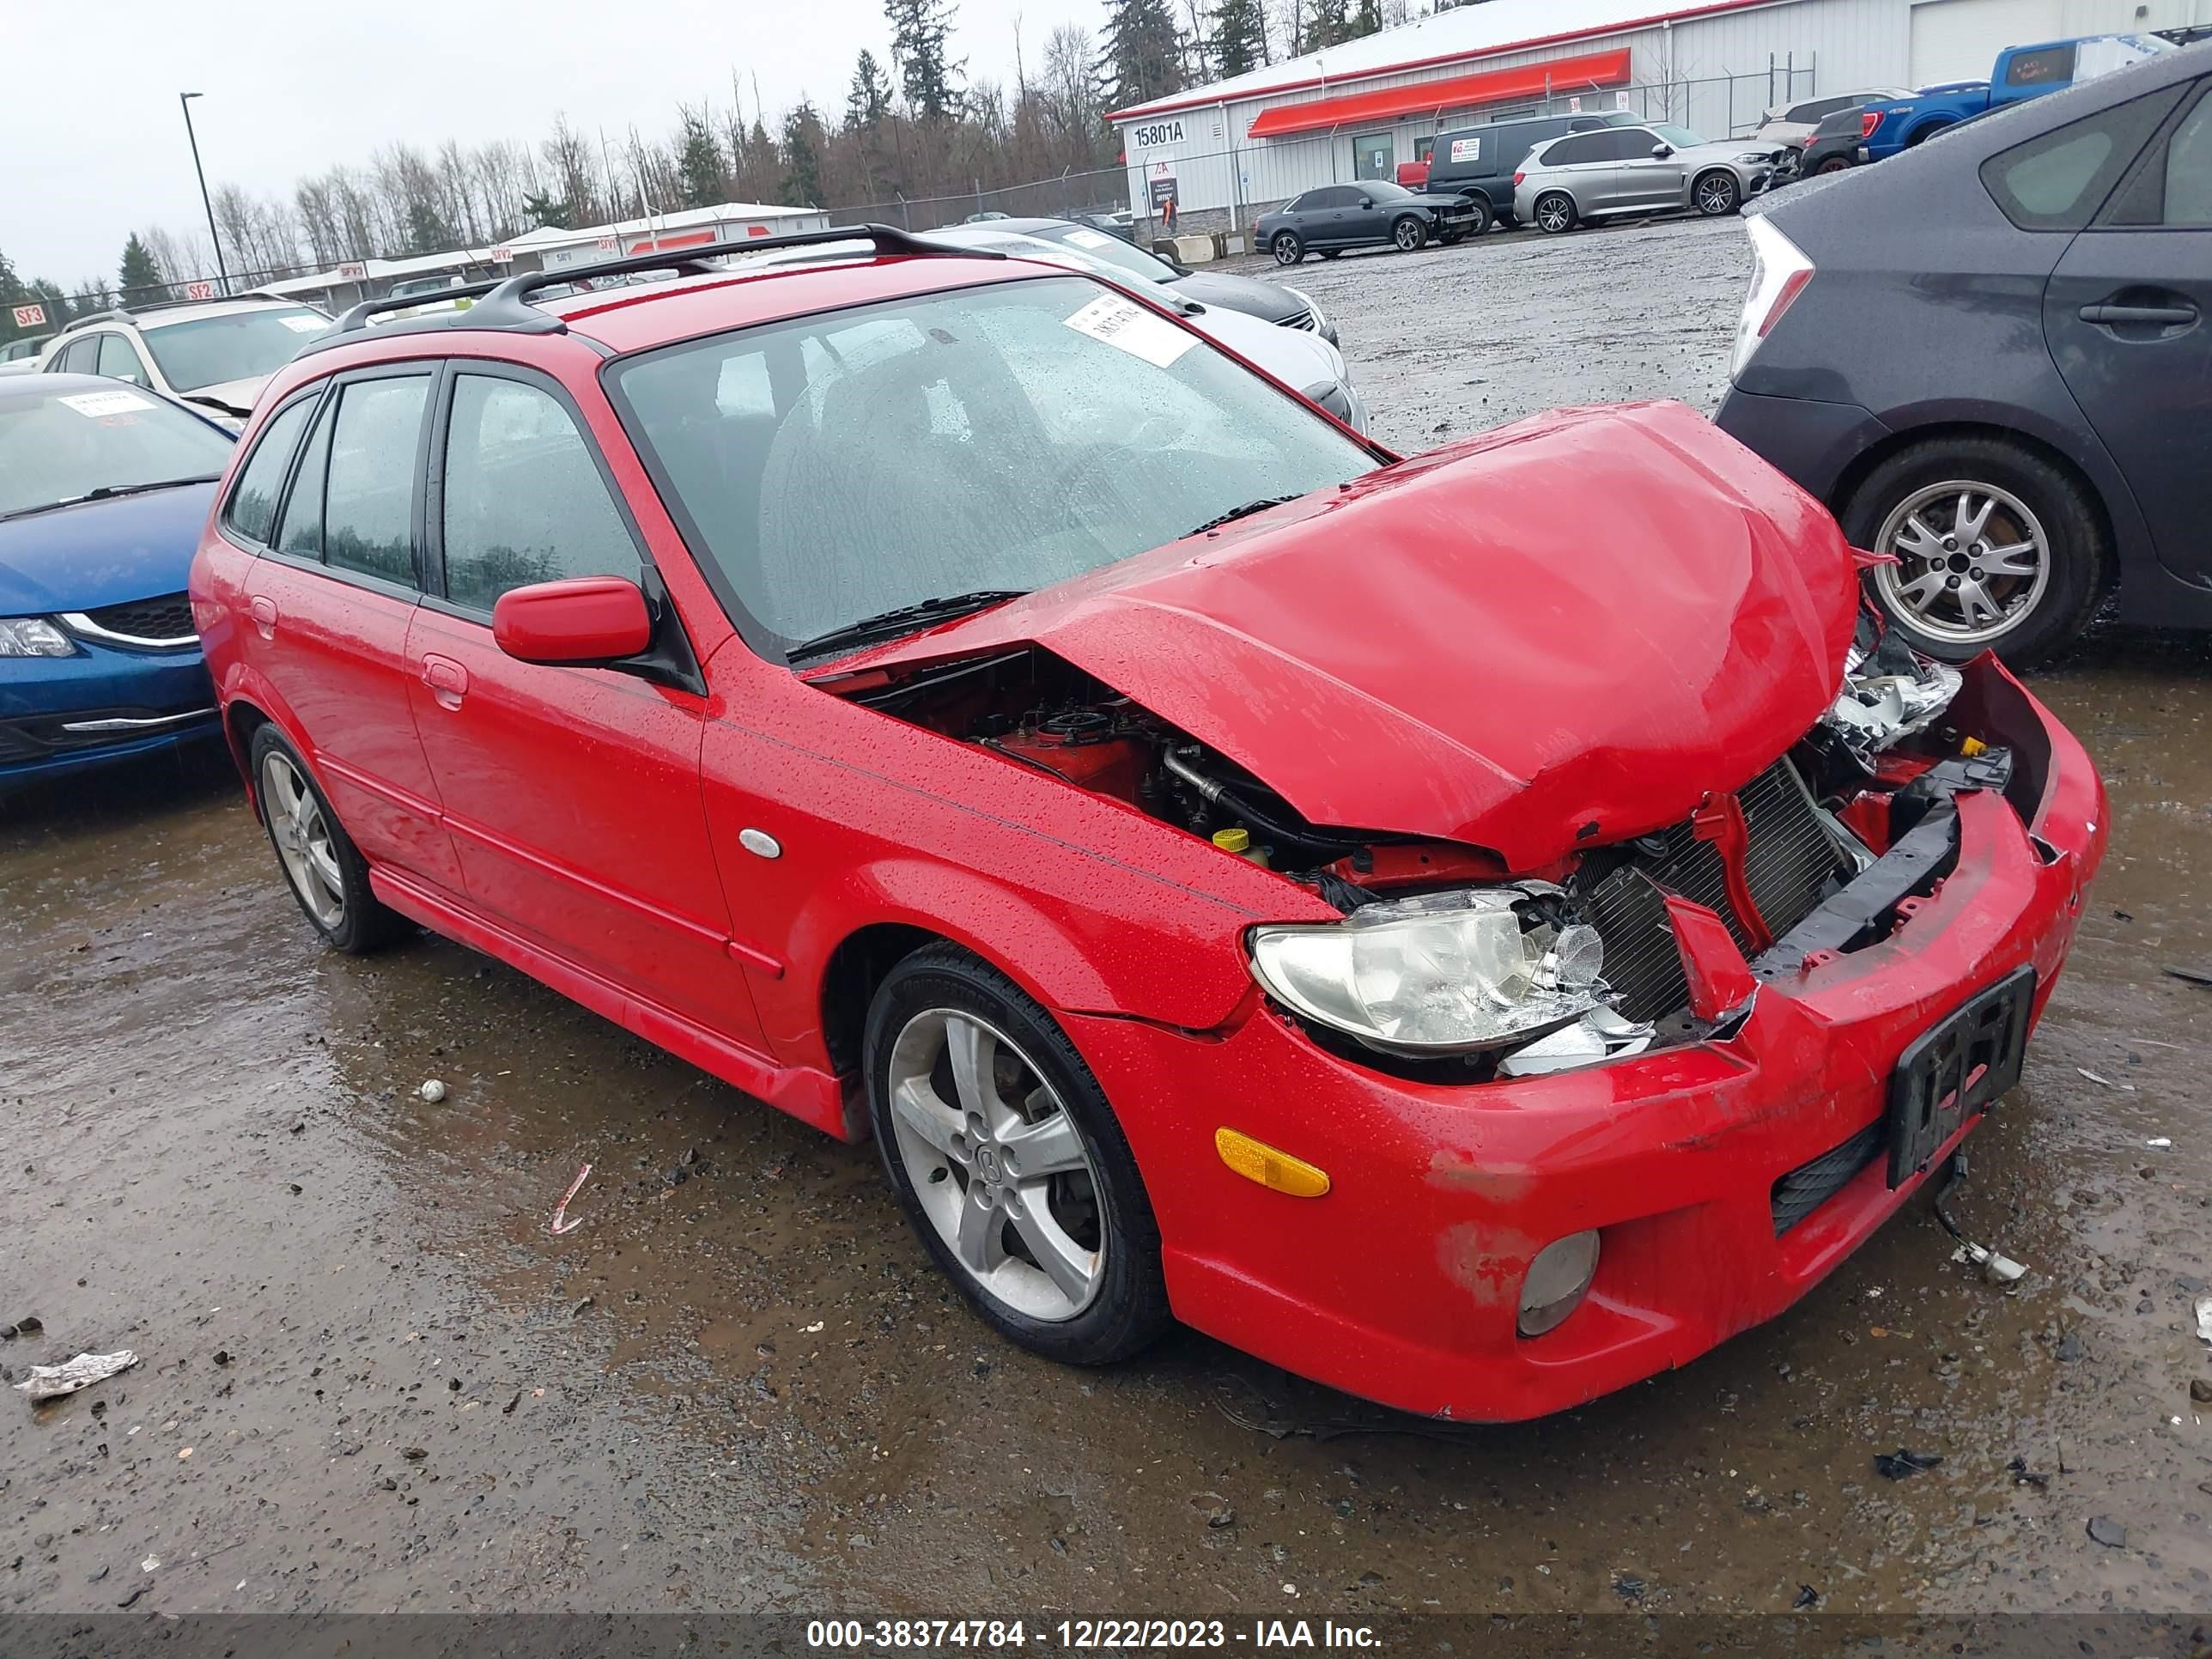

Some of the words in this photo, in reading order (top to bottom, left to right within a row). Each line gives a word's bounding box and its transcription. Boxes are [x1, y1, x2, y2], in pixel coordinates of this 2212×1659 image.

[1134, 121, 1184, 147] 15801A
[491, 248, 513, 261] SFV2
[341, 265, 363, 276] SFV3
[188, 284, 212, 300] SF2
[16, 307, 42, 325] SF3
